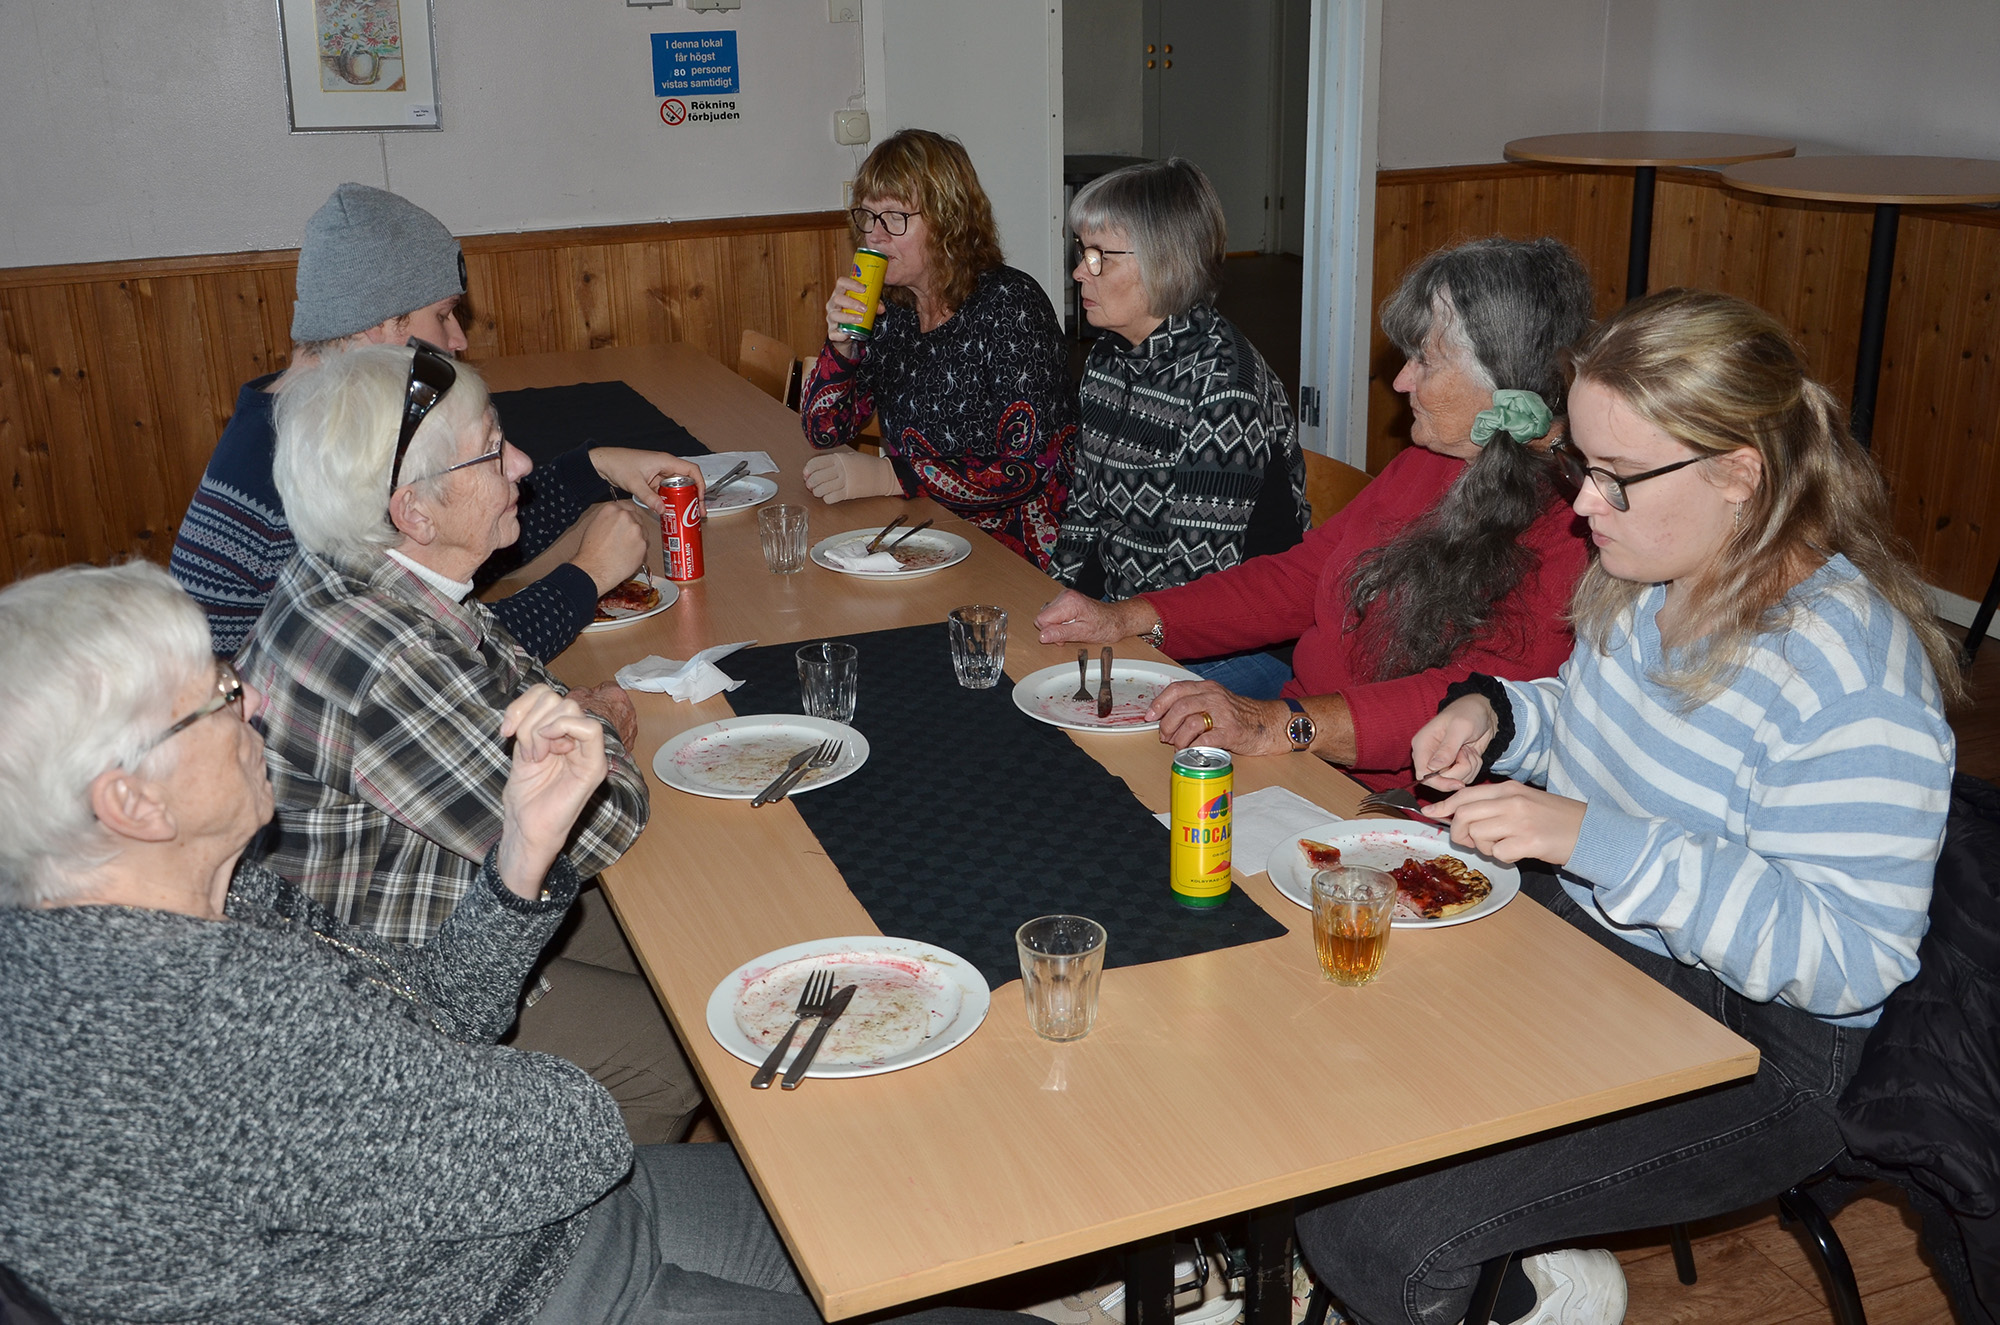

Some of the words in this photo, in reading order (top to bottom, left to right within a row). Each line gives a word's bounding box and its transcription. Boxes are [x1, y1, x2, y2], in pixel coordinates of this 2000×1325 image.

[665, 40, 669, 49] I
[671, 39, 699, 49] denna
[701, 38, 723, 48] lokal
[674, 52, 688, 62] får
[689, 51, 716, 63] högst
[673, 68, 686, 77] 80
[691, 65, 731, 76] personer
[661, 80, 688, 89] vistas
[690, 77, 732, 88] samtidigt
[691, 100, 736, 110] Rökning
[688, 111, 740, 122] förbjuden
